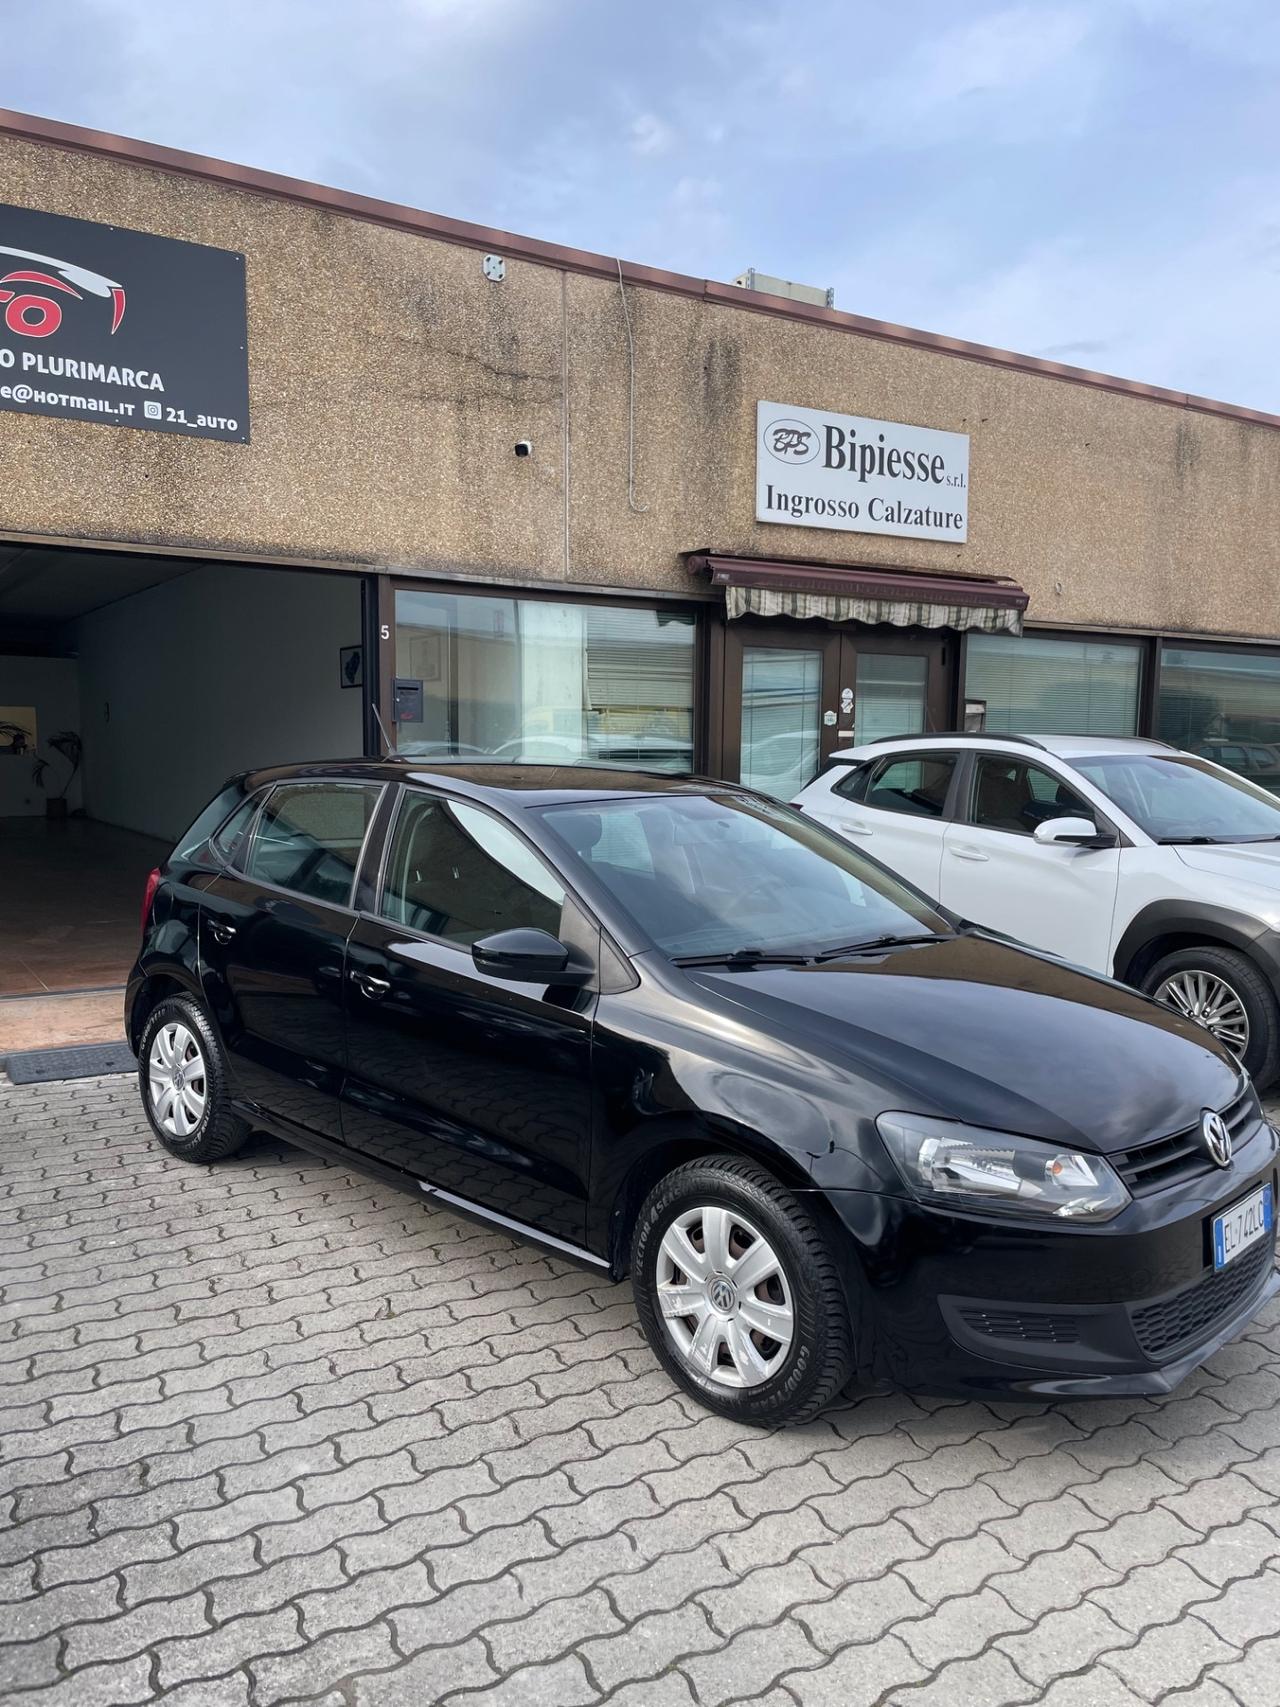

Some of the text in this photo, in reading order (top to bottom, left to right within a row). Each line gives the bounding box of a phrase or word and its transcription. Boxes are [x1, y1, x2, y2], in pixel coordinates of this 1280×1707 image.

[22, 351, 165, 392] PLURIMARCA
[821, 424, 967, 489] Bipiesse s.r.l.
[765, 484, 964, 530] Ingrosso Calzature
[380, 624, 390, 640] 5
